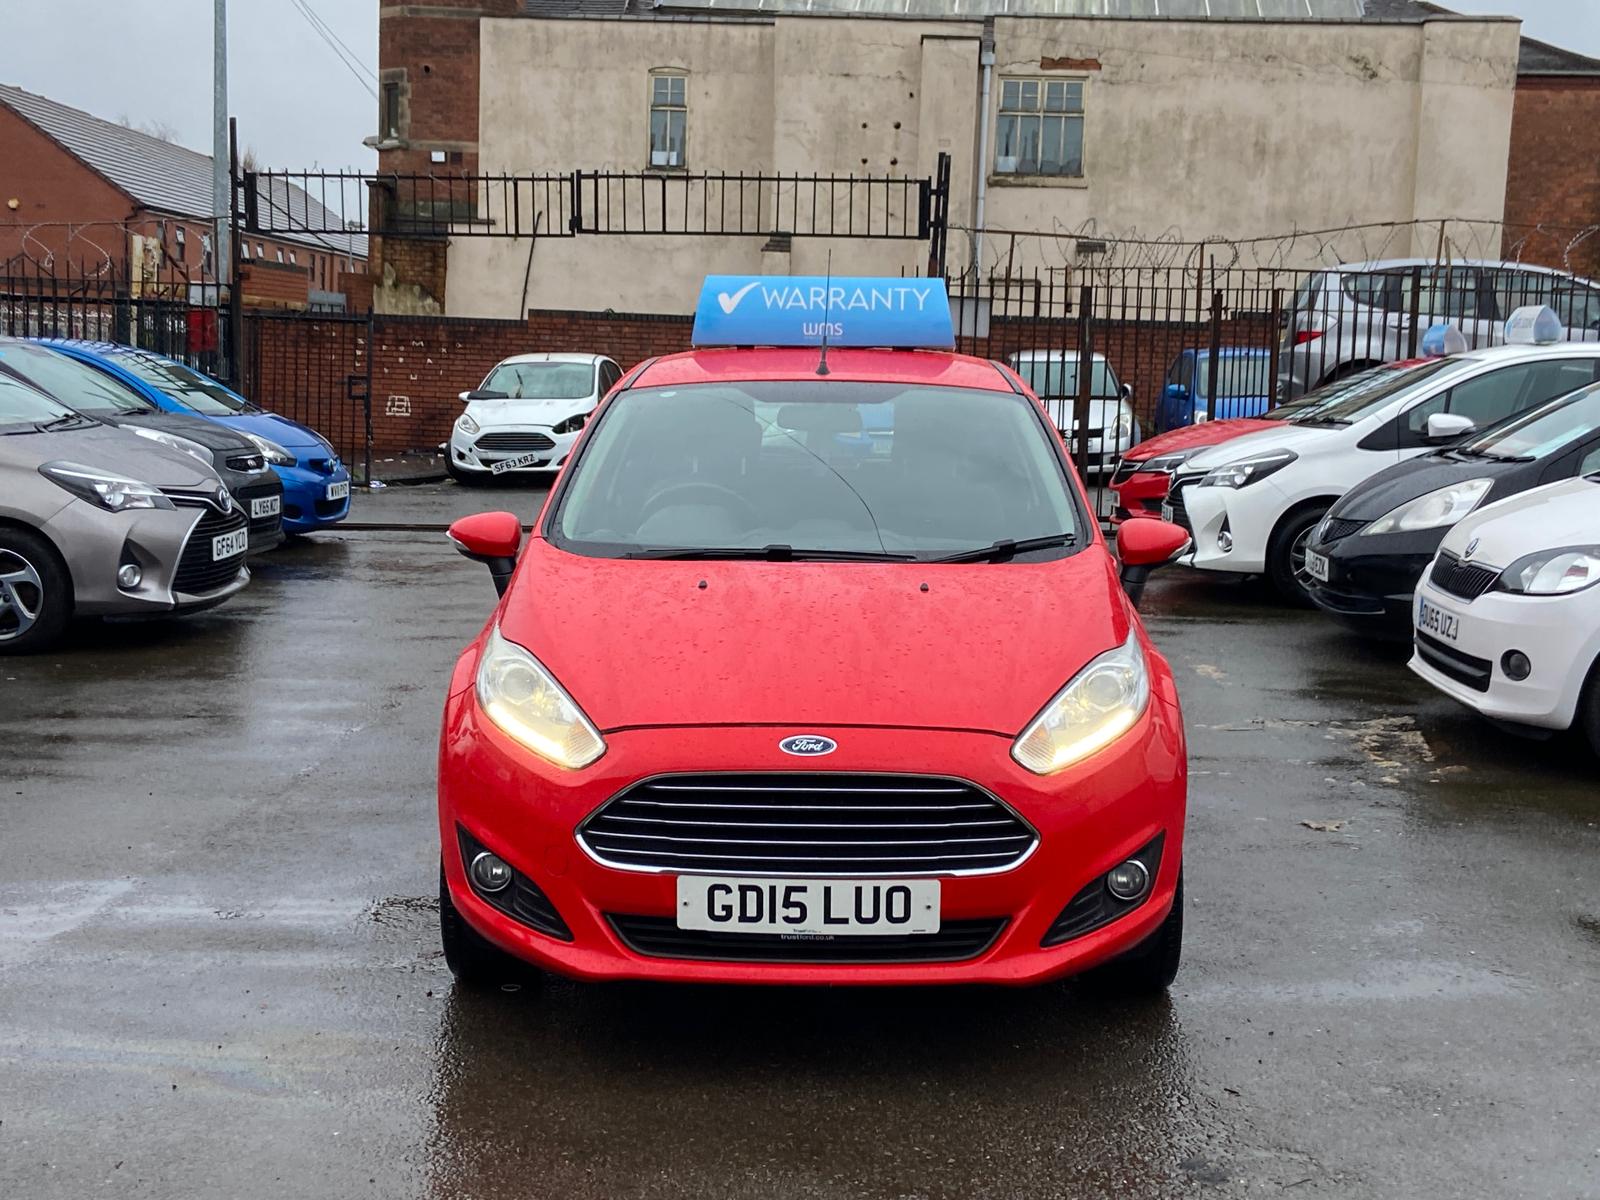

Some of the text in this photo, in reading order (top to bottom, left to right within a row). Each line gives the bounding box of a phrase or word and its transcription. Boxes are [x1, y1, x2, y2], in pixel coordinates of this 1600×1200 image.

[761, 286, 931, 311] WARRANTY
[803, 322, 844, 336] wms
[494, 453, 535, 473] SF63 KRZ
[254, 499, 270, 515] LY65
[216, 535, 234, 557] GF64
[1440, 612, 1459, 641] UZJ
[791, 738, 824, 751] Ford
[706, 883, 912, 925] GD15 LUO
